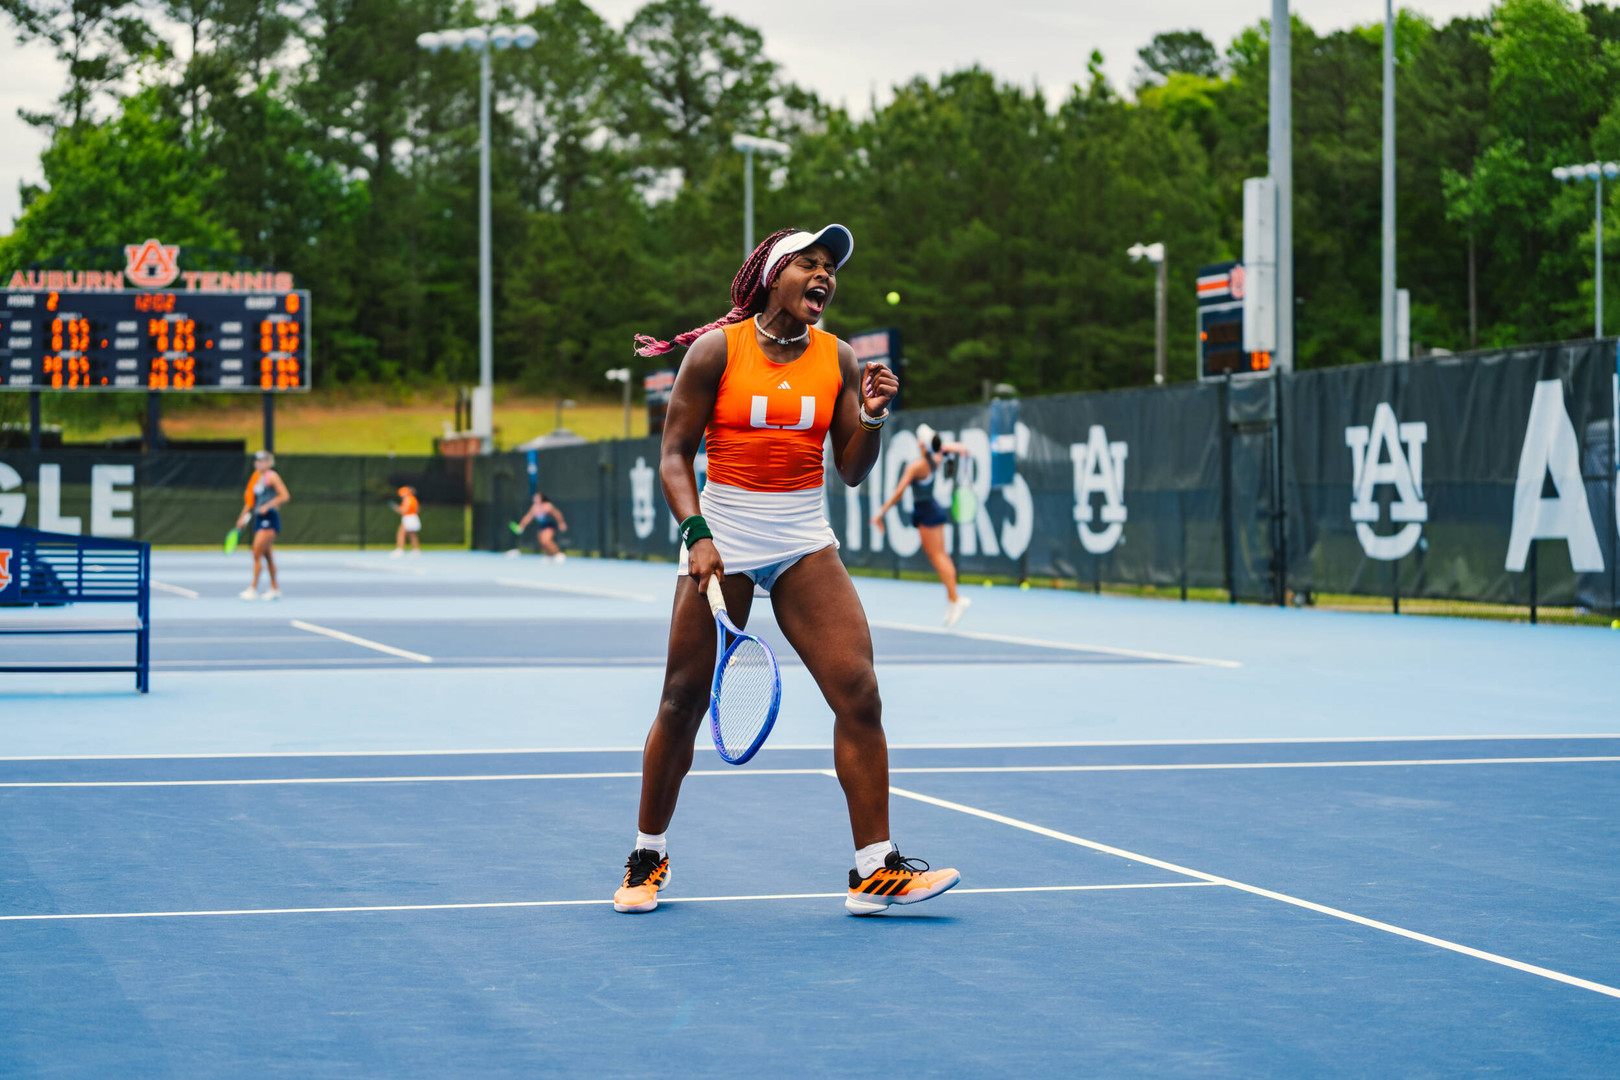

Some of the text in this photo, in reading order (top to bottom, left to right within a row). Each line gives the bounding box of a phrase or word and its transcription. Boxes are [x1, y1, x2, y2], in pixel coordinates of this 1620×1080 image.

[8, 270, 294, 293] AUBURN TENNIS
[749, 395, 816, 430] U
[1504, 374, 1620, 573] A
